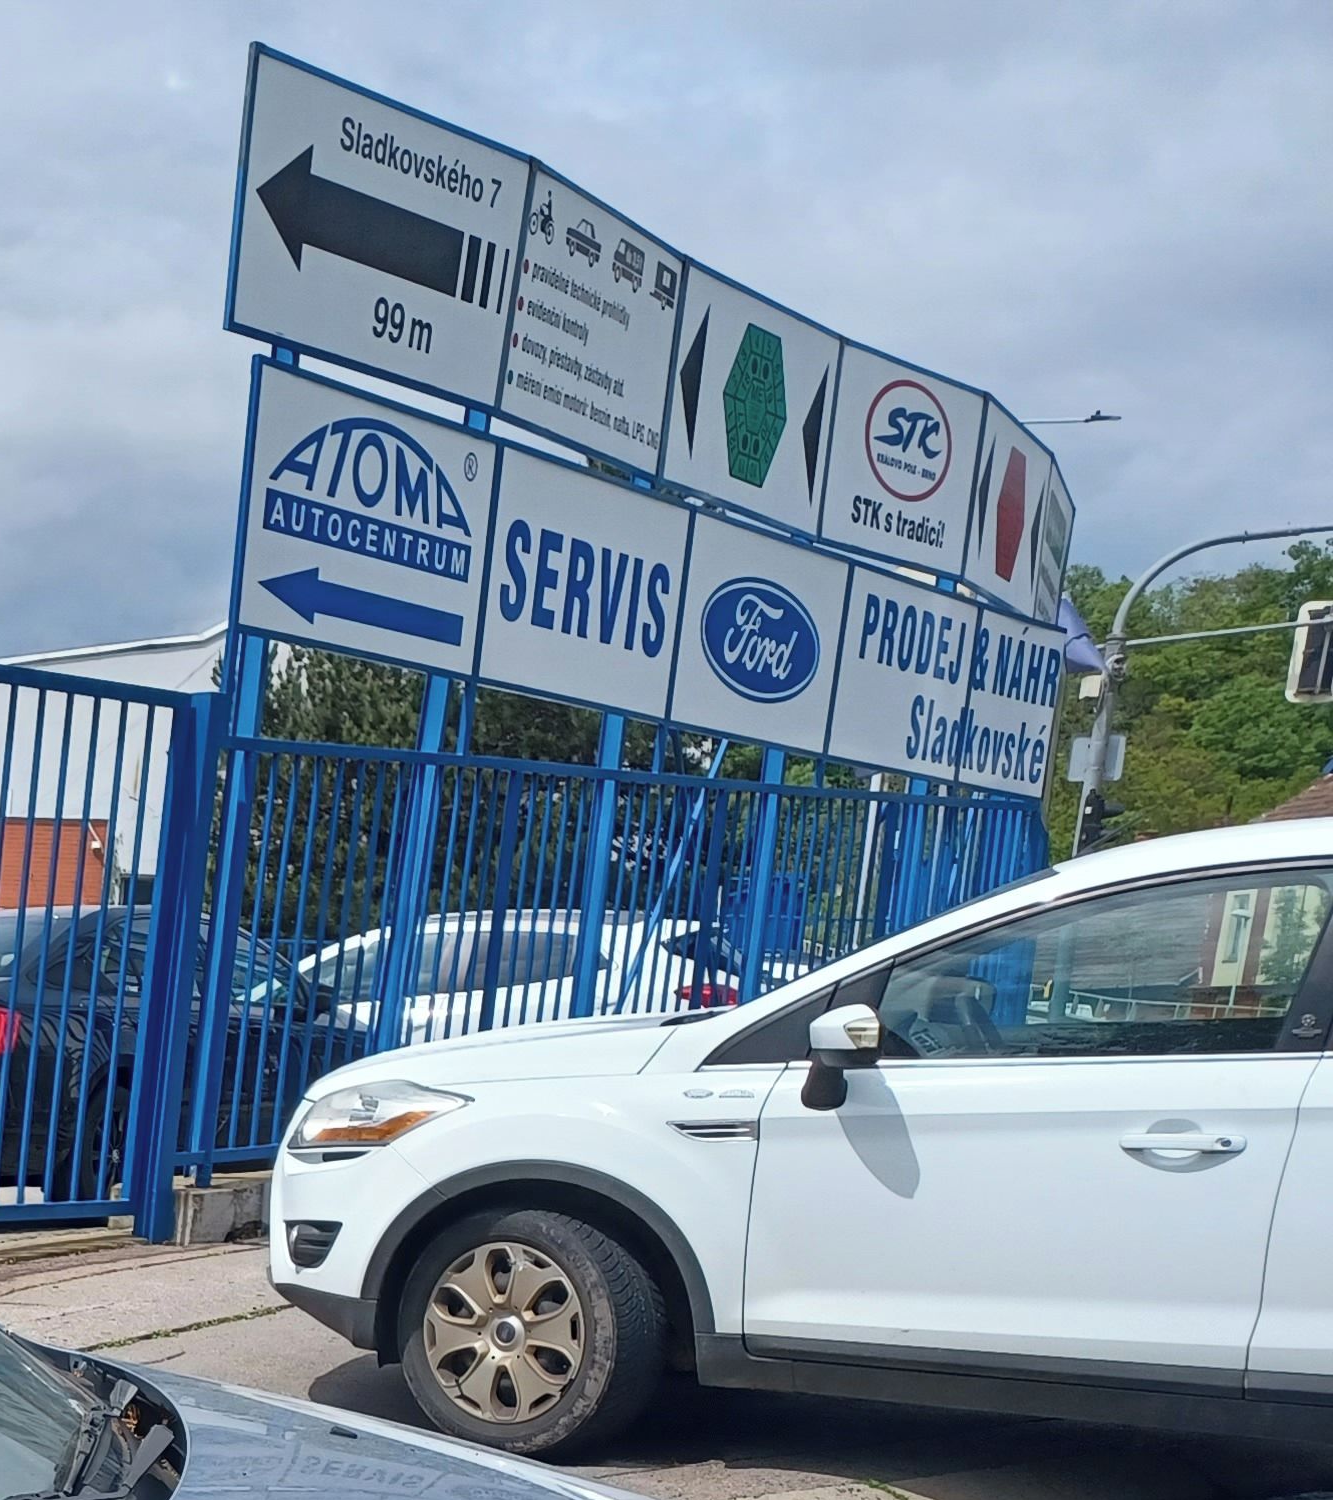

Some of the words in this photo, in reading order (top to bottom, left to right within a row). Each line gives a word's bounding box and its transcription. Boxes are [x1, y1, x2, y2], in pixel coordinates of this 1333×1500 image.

[340, 117, 483, 202] Sladkovského
[490, 178, 502, 208] 7
[372, 296, 406, 345] 99
[409, 318, 433, 354] m
[873, 407, 942, 459] STK
[269, 417, 472, 538] ATOMA
[270, 497, 466, 577] AUTOCENTRUM
[851, 495, 882, 530] STK
[884, 513, 893, 533] s
[896, 510, 945, 548] tradicí!
[500, 520, 669, 658] SERVIS
[724, 594, 798, 680] Ford
[859, 593, 966, 684] PRODEJ
[971, 628, 989, 691] &
